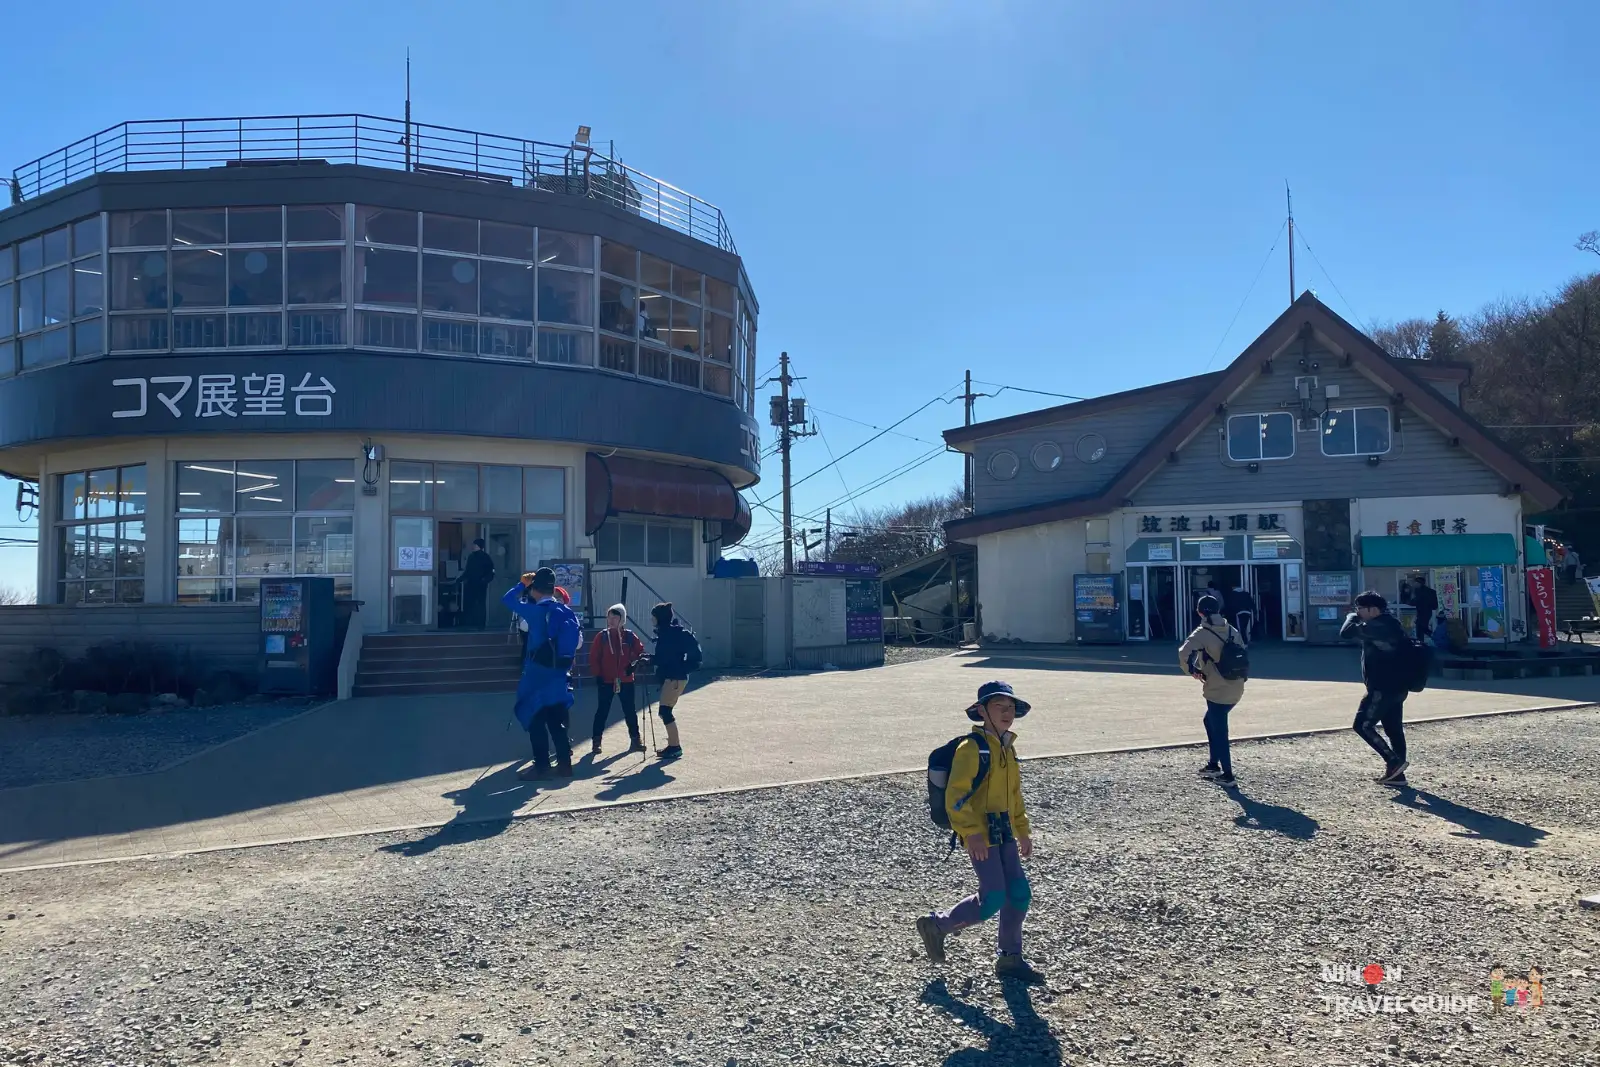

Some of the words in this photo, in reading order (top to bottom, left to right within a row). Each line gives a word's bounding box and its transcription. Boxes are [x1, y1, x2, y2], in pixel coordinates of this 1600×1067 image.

[112, 372, 336, 418] コマ展望台
[1142, 513, 1281, 532] 筑波山頂駅
[1386, 517, 1468, 536] 軽食喫茶
